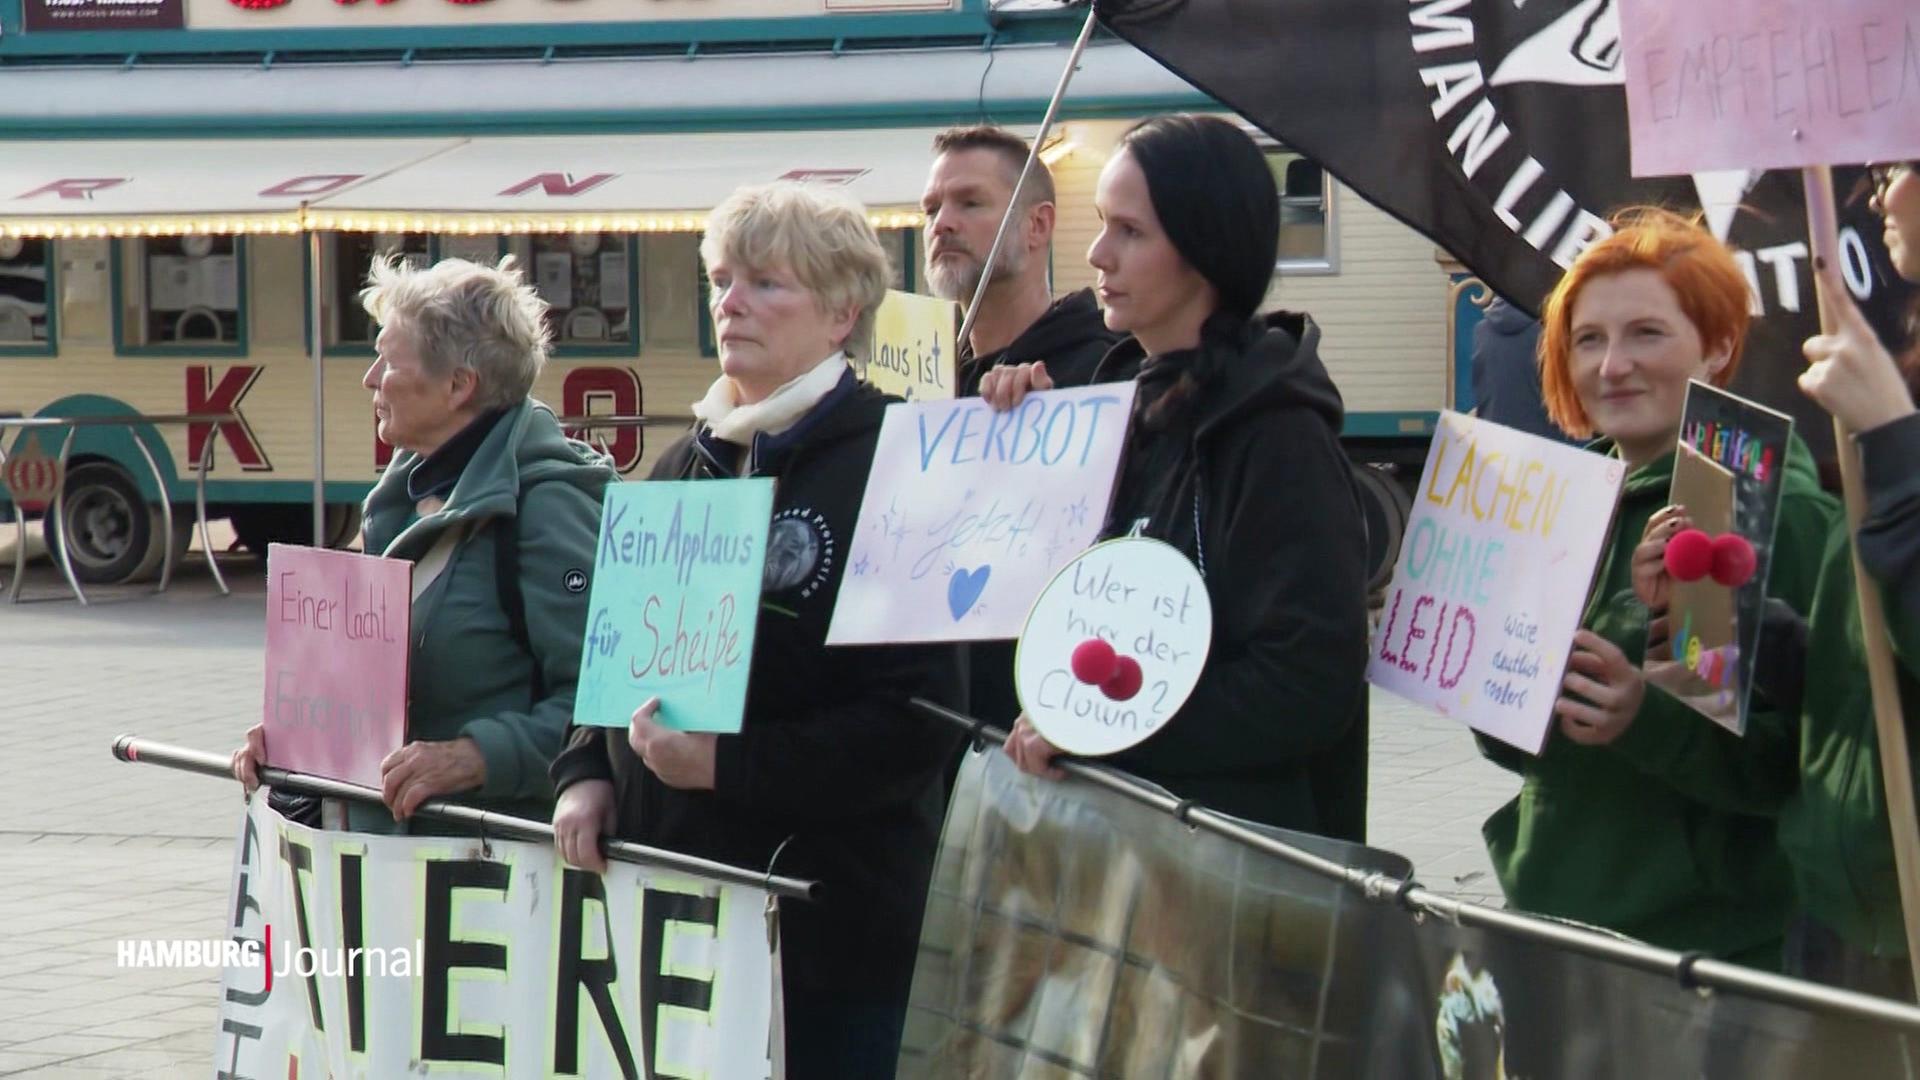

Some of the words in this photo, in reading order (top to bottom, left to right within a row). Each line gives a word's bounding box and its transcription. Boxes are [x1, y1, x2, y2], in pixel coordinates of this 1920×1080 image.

[917, 328, 944, 388] ist
[918, 396, 1121, 473] VERBOT
[1426, 438, 1569, 540] LACHEN
[601, 495, 657, 568] Kein
[662, 499, 754, 586] Applaus
[1406, 516, 1504, 607] OHNE
[281, 572, 337, 631] Einer
[1066, 609, 1119, 641] hier
[1134, 629, 1191, 664] der
[1072, 561, 1138, 603] Wer
[1153, 584, 1193, 625] ist
[1380, 588, 1476, 689] LEID
[586, 607, 622, 669] für
[630, 594, 741, 693] Scheiße
[278, 833, 722, 1080] TIERE
